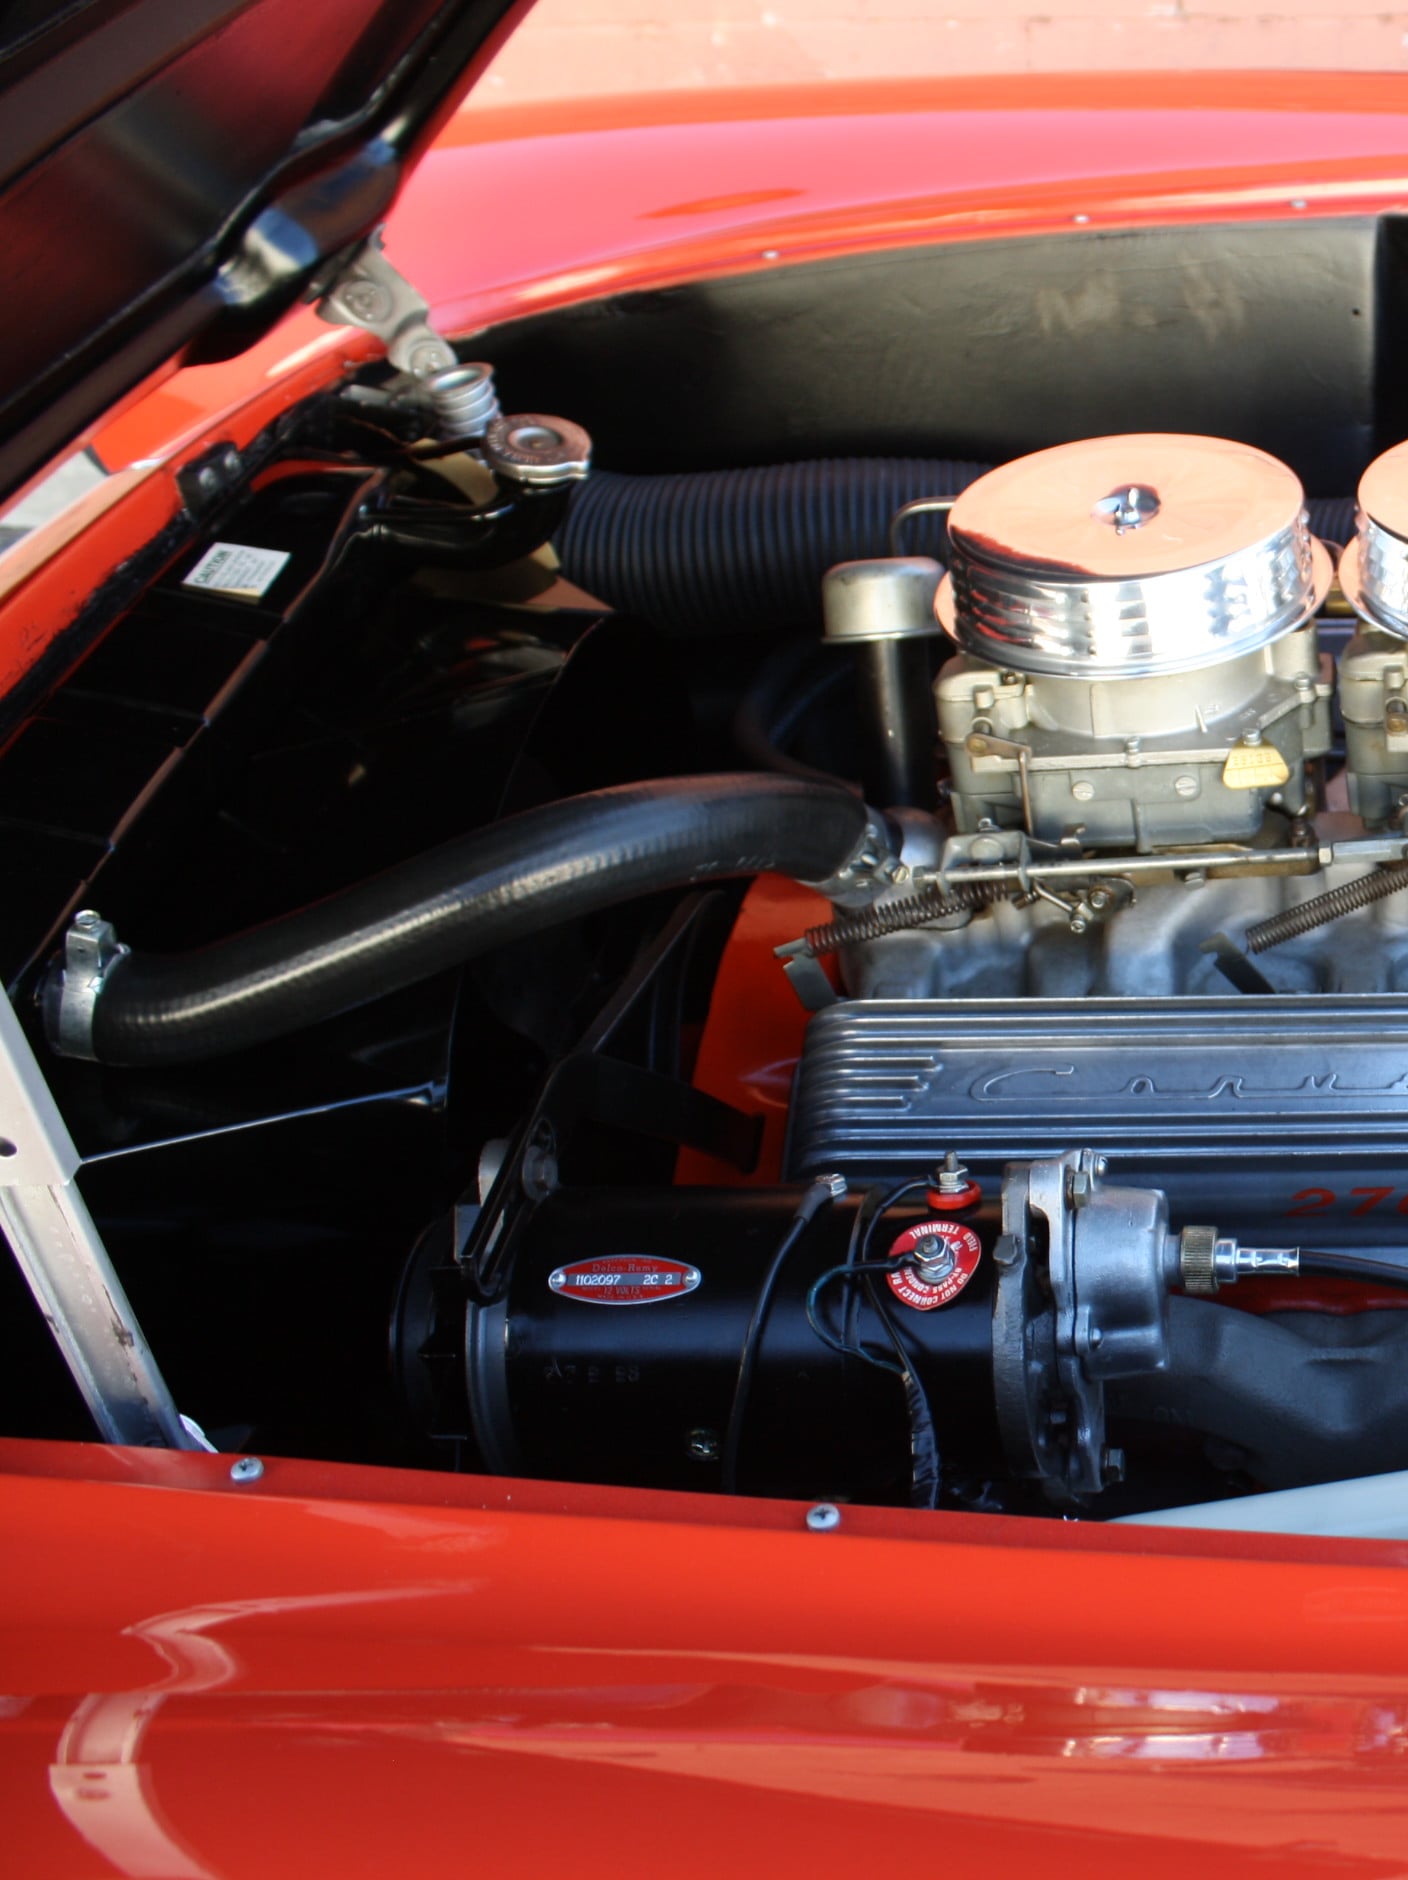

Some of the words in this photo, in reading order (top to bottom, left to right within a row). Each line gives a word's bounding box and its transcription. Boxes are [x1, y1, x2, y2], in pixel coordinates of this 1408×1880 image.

[909, 1223, 960, 1239] TERMINAL
[963, 1232, 978, 1252] FIELD
[576, 1274, 621, 1286] 1102097
[643, 1274, 659, 1286] 2C
[664, 1274, 673, 1286] 2
[957, 1272, 969, 1285] DO
[898, 1286, 938, 1305] CONNECT
[940, 1284, 958, 1300] NOT
